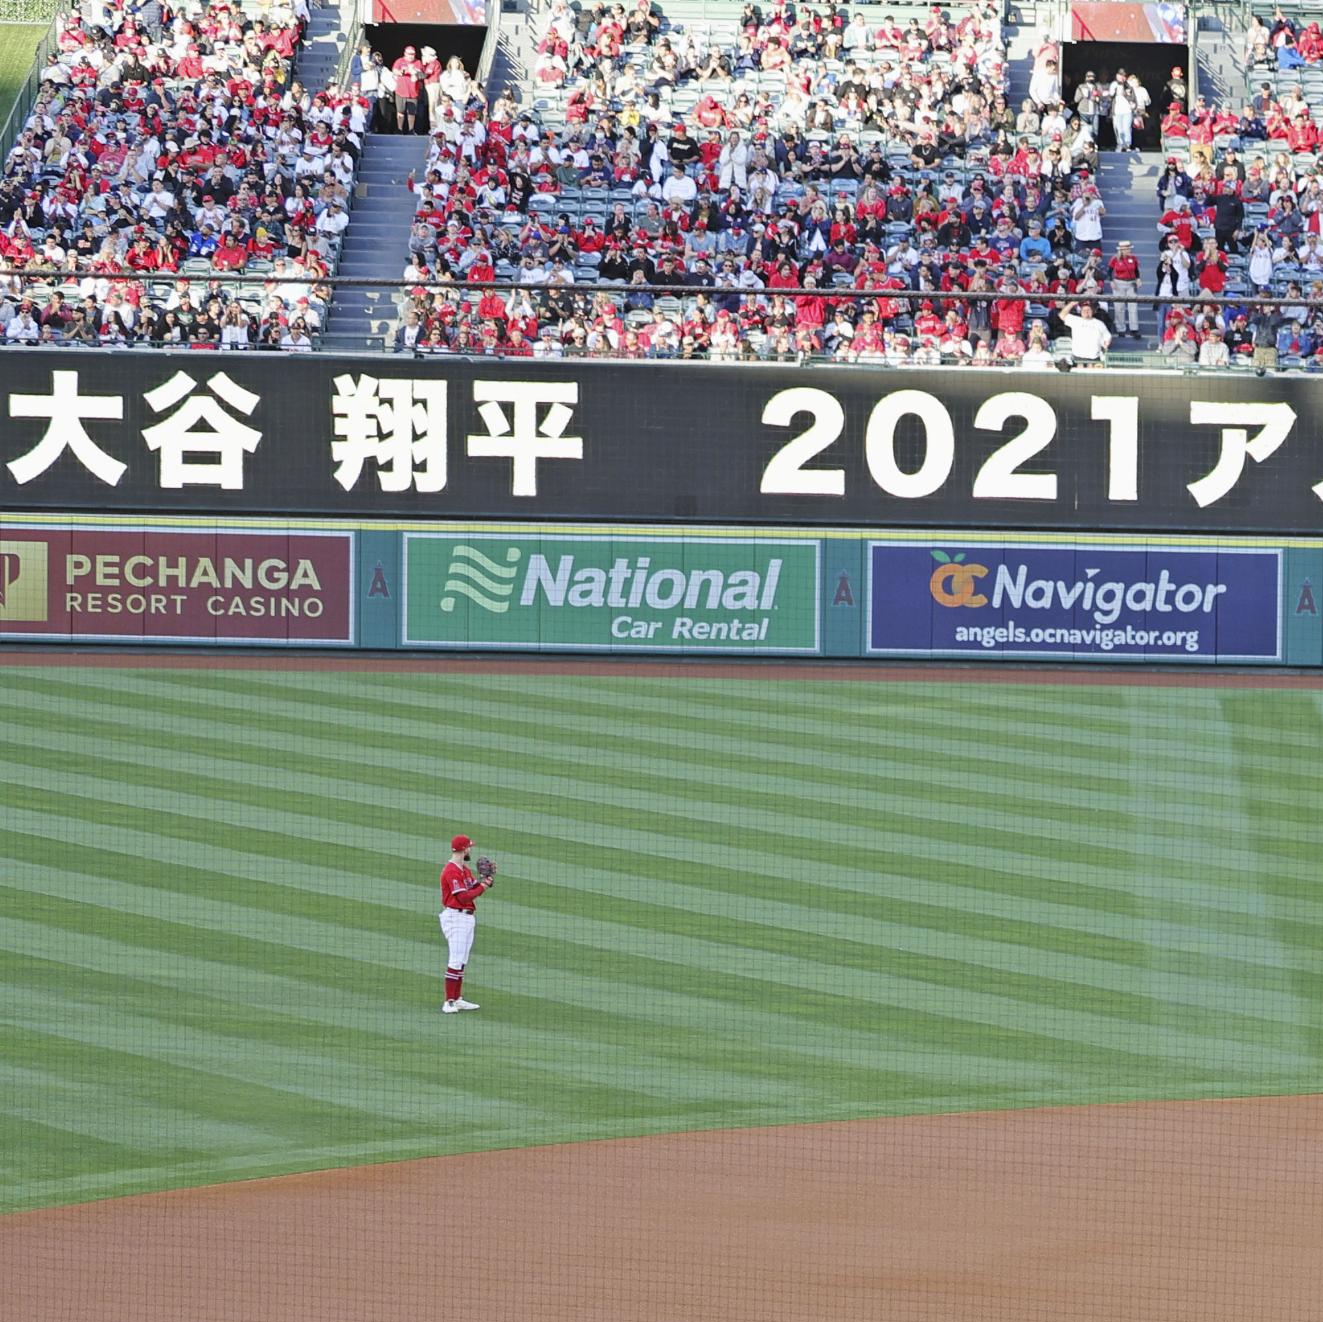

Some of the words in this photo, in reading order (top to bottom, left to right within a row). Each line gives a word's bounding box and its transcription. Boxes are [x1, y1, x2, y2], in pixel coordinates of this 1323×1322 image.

[5, 370, 263, 490] 大谷
[331, 373, 584, 497] 翔平
[66, 554, 321, 592] PECHANGA
[520, 554, 783, 610] National
[66, 593, 187, 615] RESORT
[207, 595, 324, 618] CASINO
[993, 563, 1227, 625] Navigator
[611, 616, 662, 639] Car
[672, 617, 769, 641] Rental
[955, 621, 1200, 651] angels.ocnavigator.org
